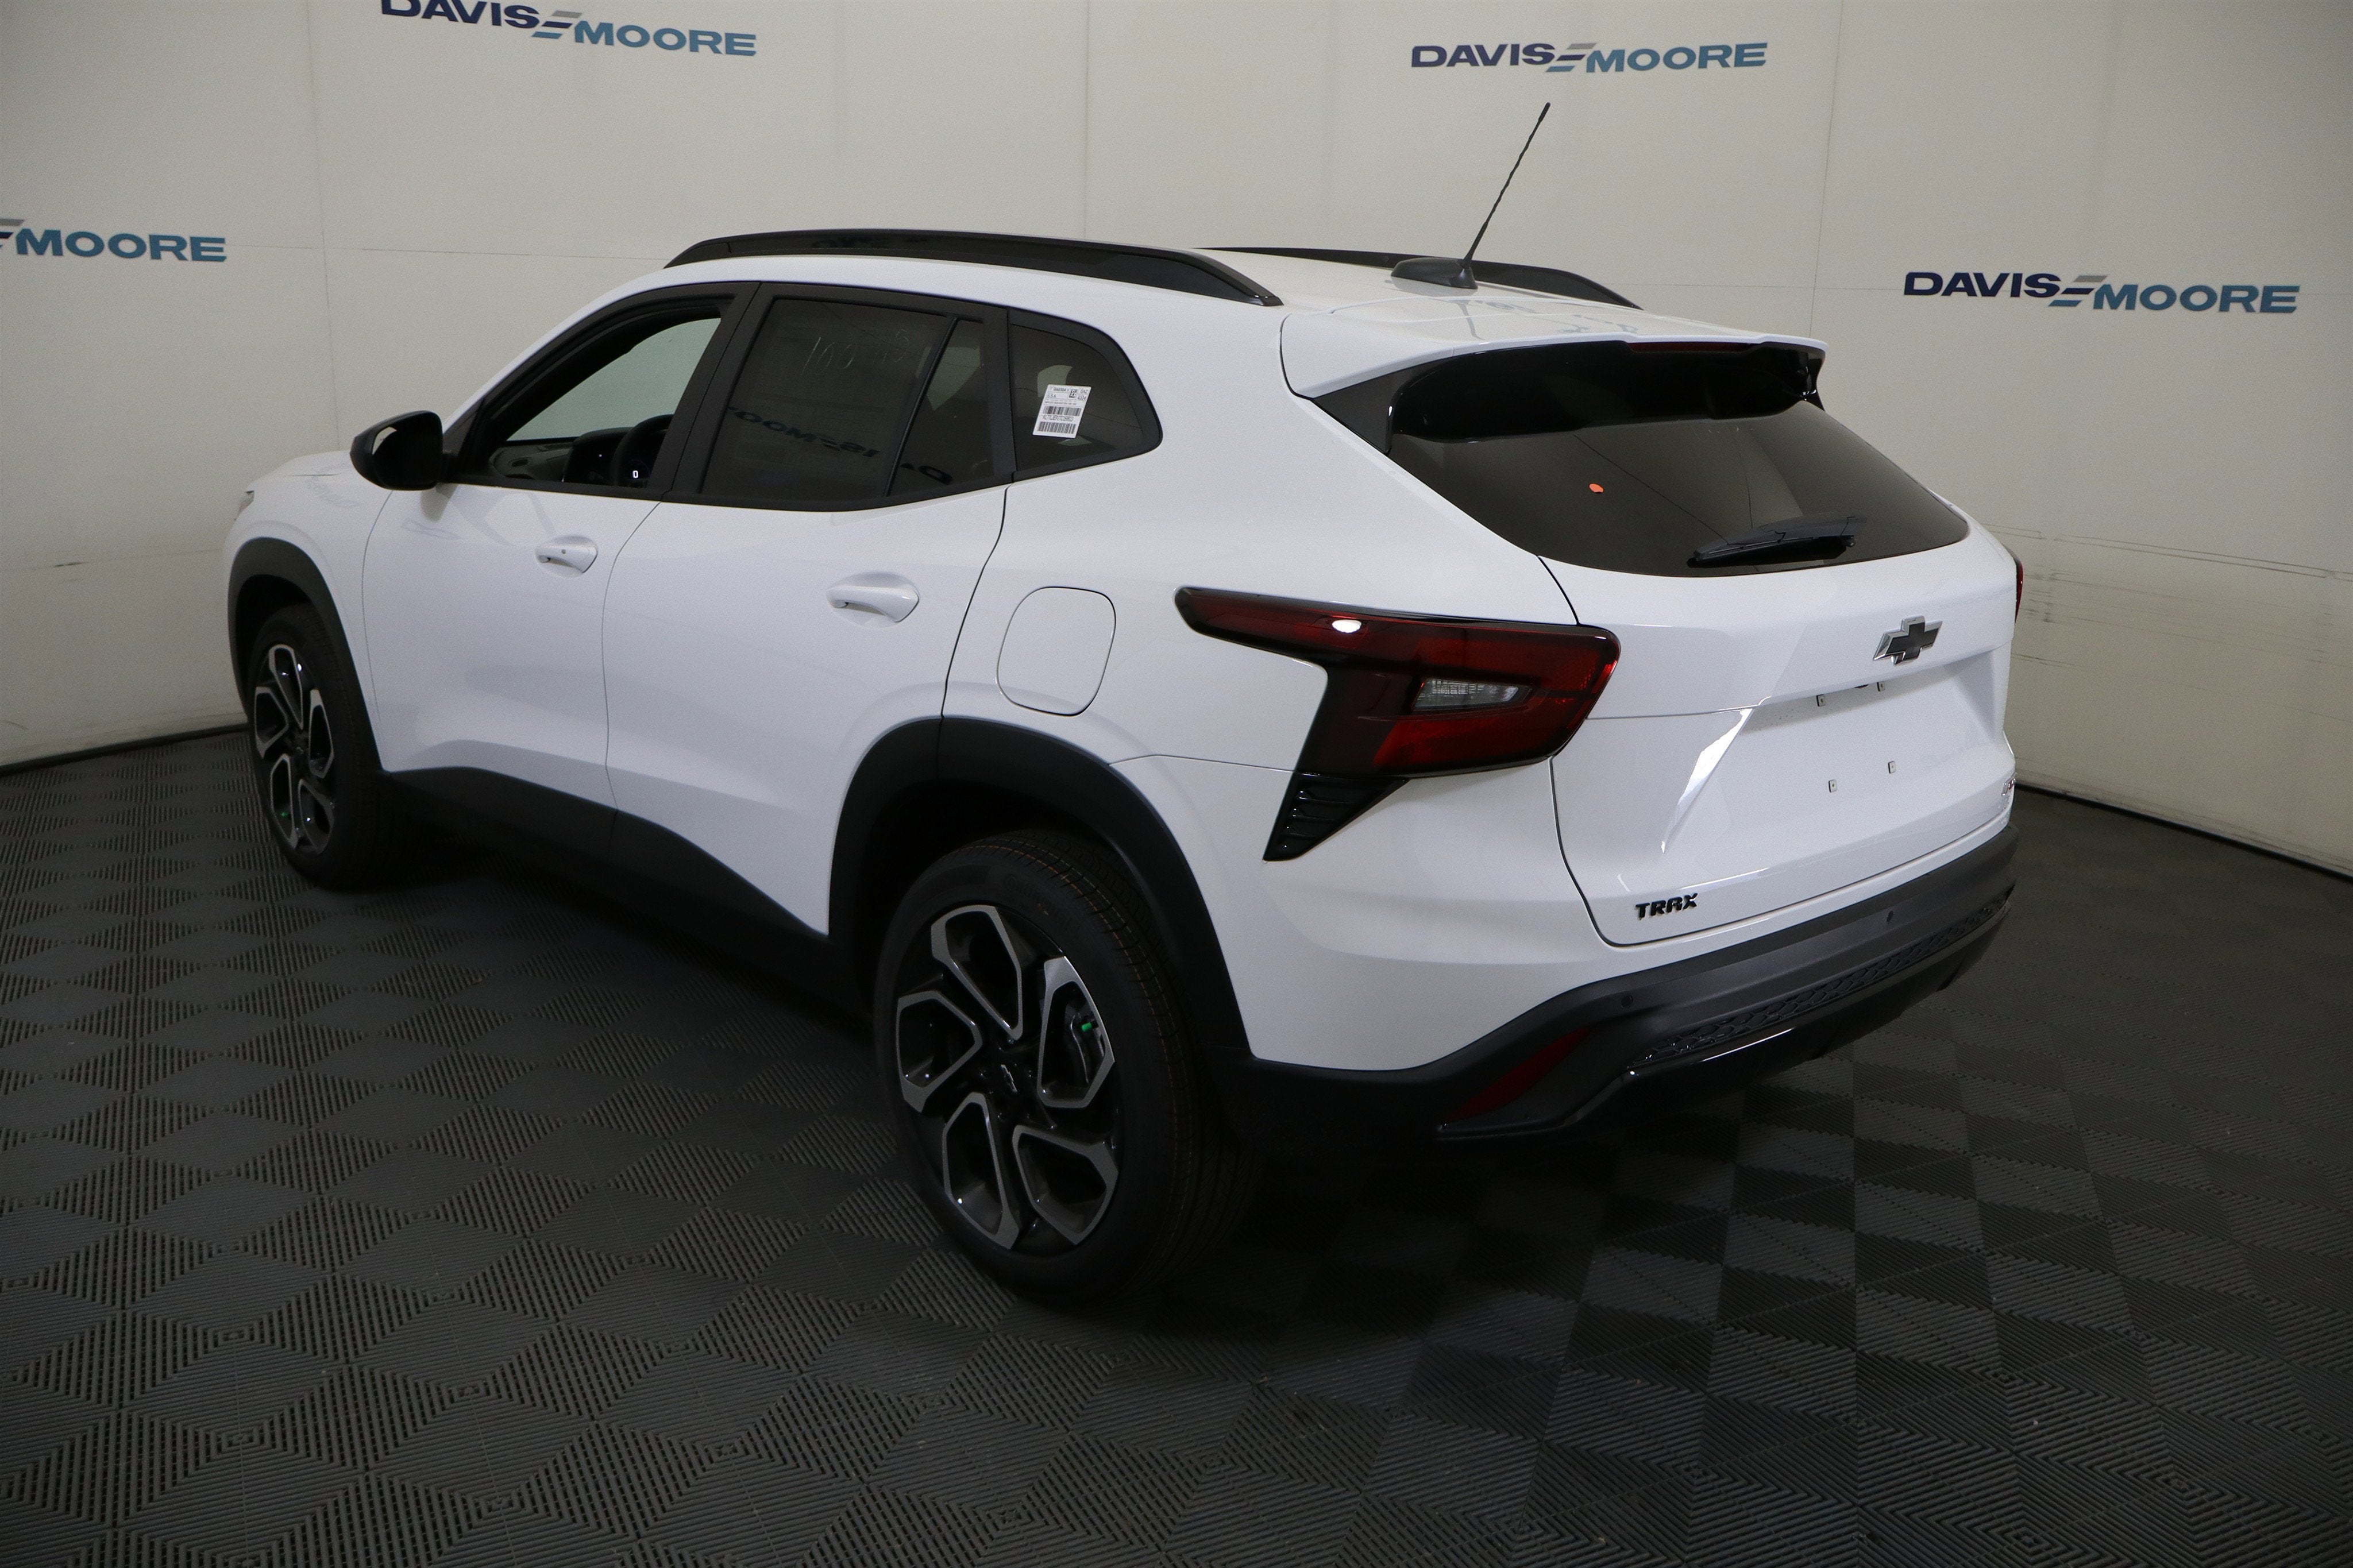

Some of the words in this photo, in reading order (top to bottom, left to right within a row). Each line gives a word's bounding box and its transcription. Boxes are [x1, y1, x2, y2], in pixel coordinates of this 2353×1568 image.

[381, 0, 540, 29] DAVIS
[574, 21, 757, 56] MOORE
[1411, 43, 1556, 68] DAVIS
[1586, 43, 1768, 73] MOORE
[16, 228, 227, 262] MOORE
[1903, 272, 2061, 298] DAVIS
[2093, 284, 2300, 314] MOORE
[632, 470, 639, 478] 0
[1635, 893, 1698, 919] TRAX
